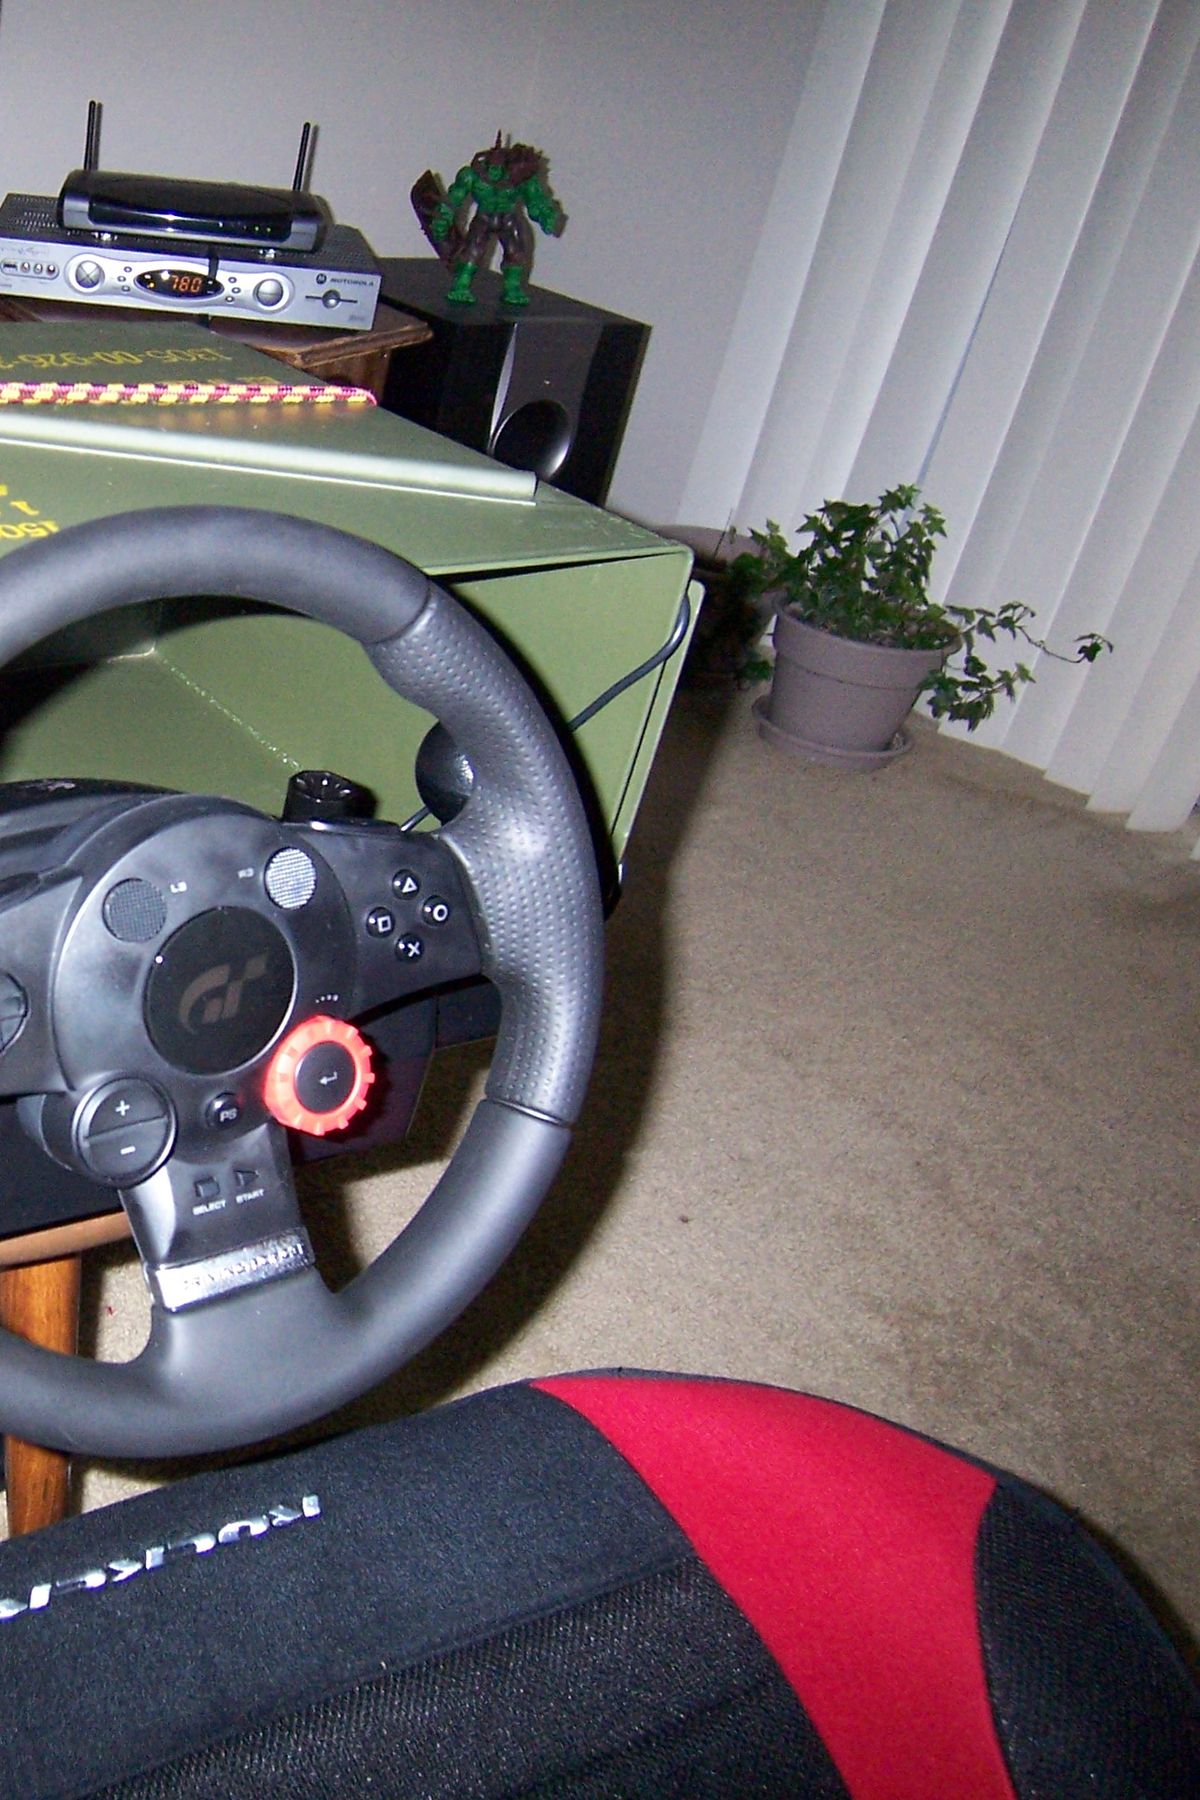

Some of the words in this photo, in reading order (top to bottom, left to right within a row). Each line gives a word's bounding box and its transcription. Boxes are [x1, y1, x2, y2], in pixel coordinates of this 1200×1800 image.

[171, 274, 202, 292] 780
[219, 1107, 238, 1122] PS
[235, 1188, 265, 1203] START
[192, 1199, 226, 1215] SELECT
